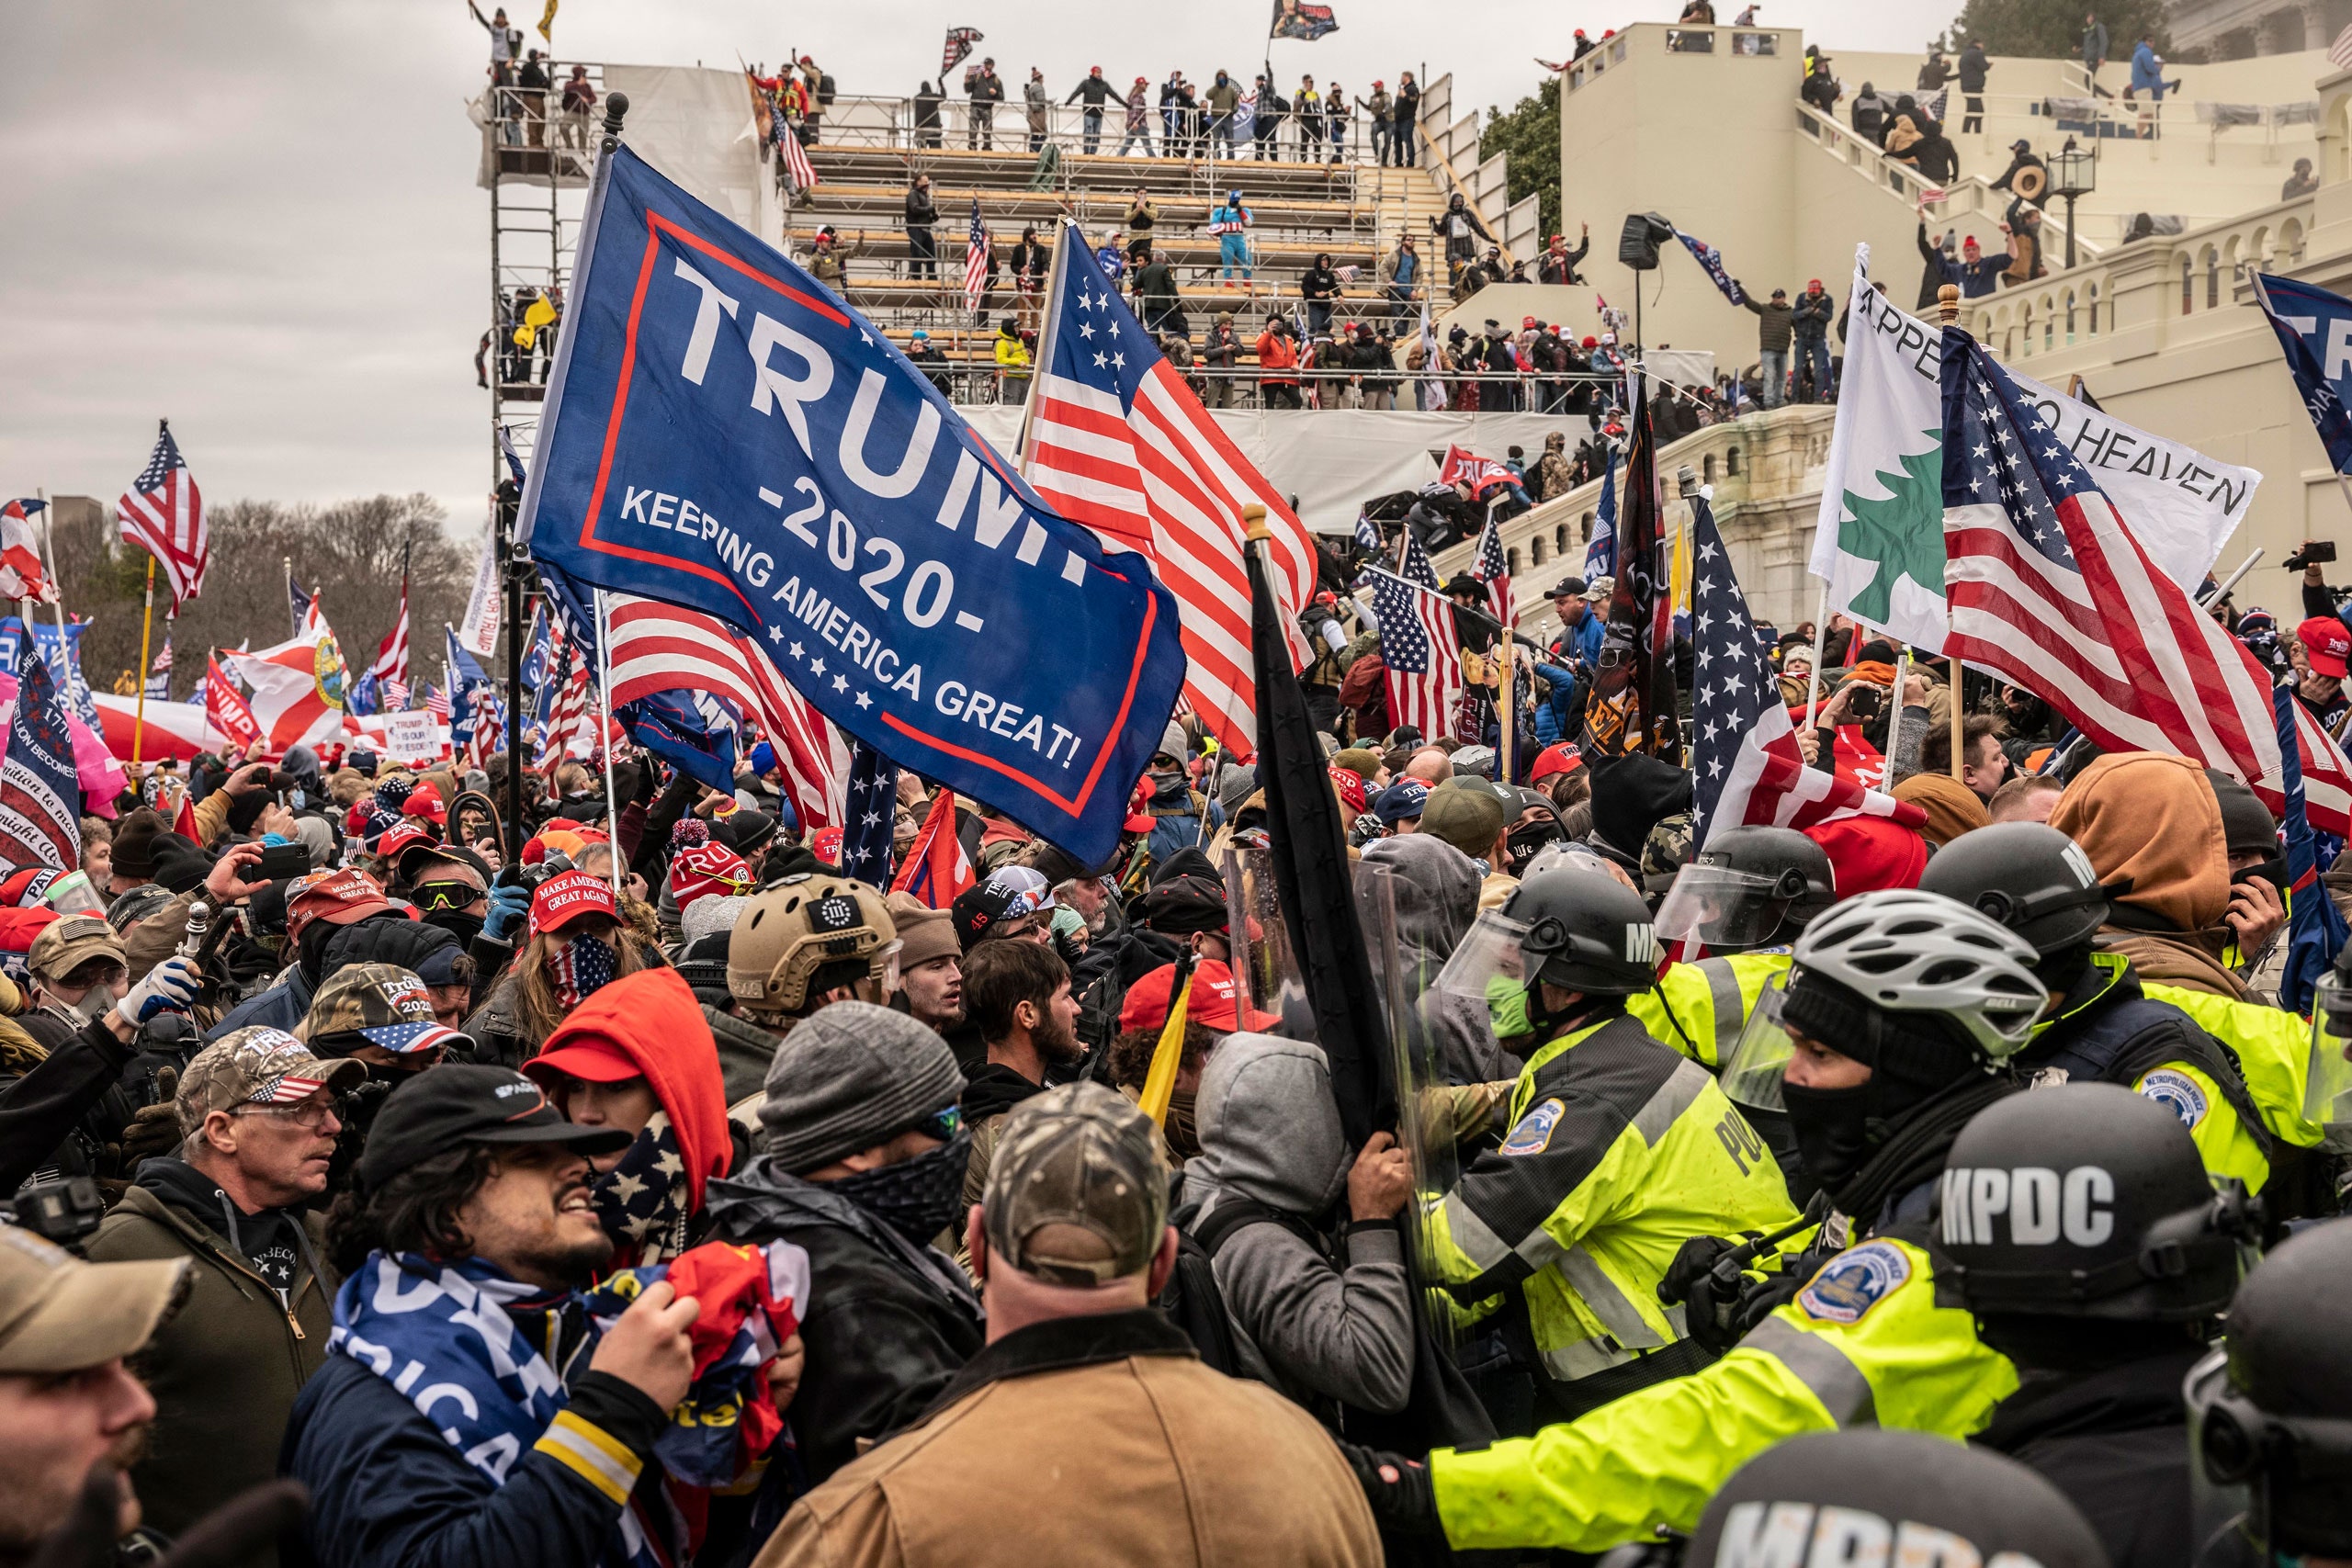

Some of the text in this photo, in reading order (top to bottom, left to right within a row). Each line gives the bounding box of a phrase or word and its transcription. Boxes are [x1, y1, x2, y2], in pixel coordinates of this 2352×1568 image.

[1859, 287, 1941, 384] APPE
[2071, 418, 2247, 516] HEAVEN
[673, 255, 1085, 587] TRUM
[1453, 458, 1508, 485] TRUMP
[477, 616, 499, 652] TRUMP
[620, 485, 1082, 771] KEEPING AMERICA GREAT!
[43, 707, 72, 744] 1776
[395, 719, 423, 729] TRUMP
[410, 731, 425, 739] OUR
[396, 740, 435, 751] PESDET
[30, 743, 75, 779] BECOMES
[42, 792, 55, 809] to
[388, 822, 422, 839] TRUMP
[1514, 843, 1534, 857] We
[675, 845, 731, 882] TRU
[332, 881, 356, 894] MAKE
[538, 875, 612, 900] MAKE AMERICA
[737, 871, 747, 883] 45
[339, 887, 366, 899] GREAT
[548, 890, 609, 911] GREAT AGAIN
[828, 905, 844, 919] III
[971, 912, 989, 931] 45
[401, 1000, 432, 1013] 2020
[243, 1028, 294, 1056] TRU
[2145, 1075, 2205, 1112] METROPOLITAN POLICE
[1714, 1105, 1763, 1179] POL
[1941, 1165, 2114, 1248] MPDC
[266, 1247, 297, 1266] BECO
[1714, 1499, 2048, 1568] MPD
